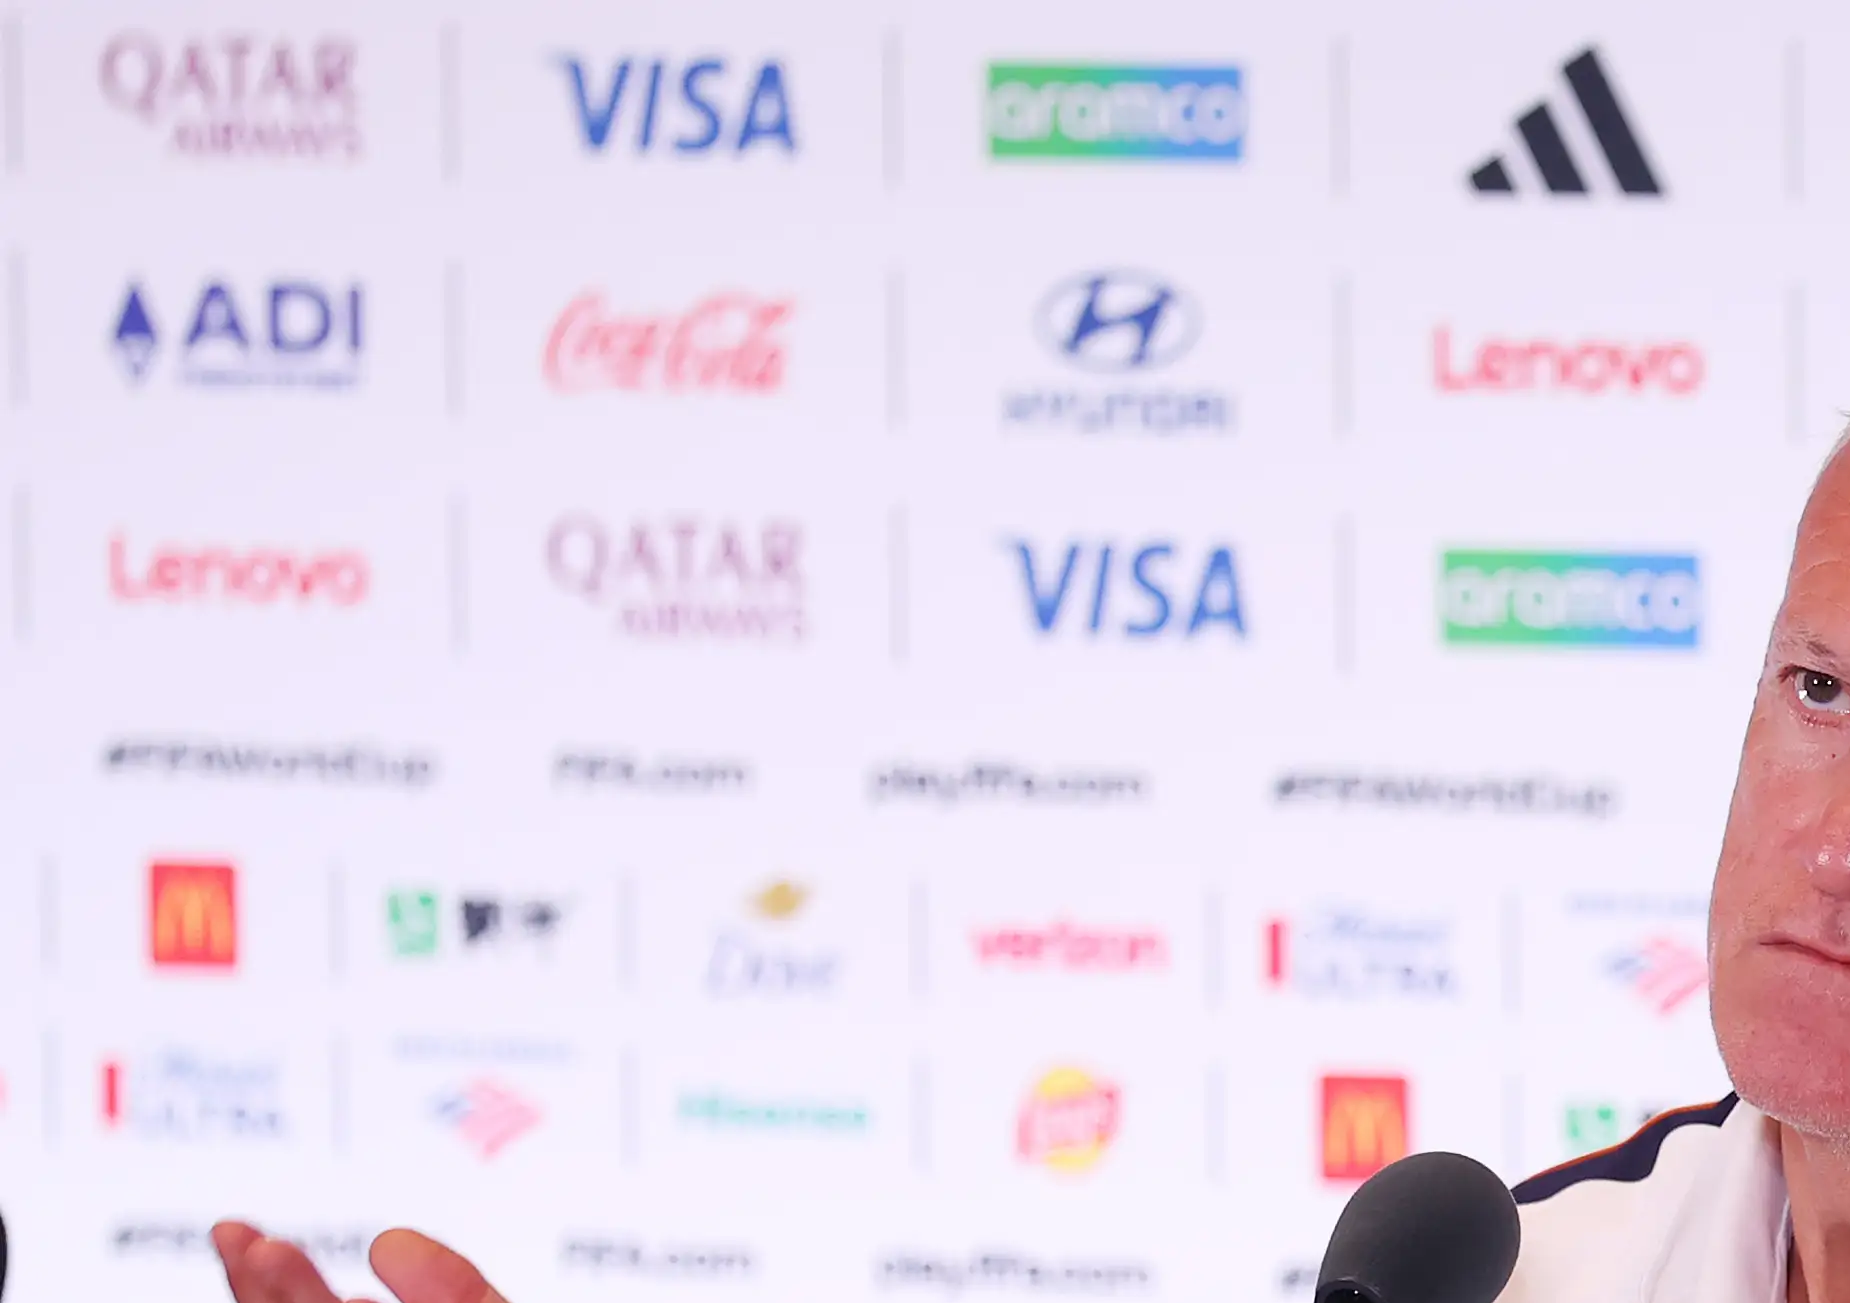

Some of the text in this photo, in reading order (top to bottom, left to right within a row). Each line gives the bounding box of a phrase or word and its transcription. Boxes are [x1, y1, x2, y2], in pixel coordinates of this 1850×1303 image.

[98, 37, 356, 122] QATAR
[561, 58, 796, 153] VISA
[990, 80, 1243, 145] aramco
[184, 281, 362, 355] ADI
[1432, 327, 1704, 395] Lenovo
[109, 535, 369, 605] Lenovo
[545, 517, 804, 606] QATAR
[1012, 540, 1248, 637] VISA
[1440, 568, 1696, 633] aramco
